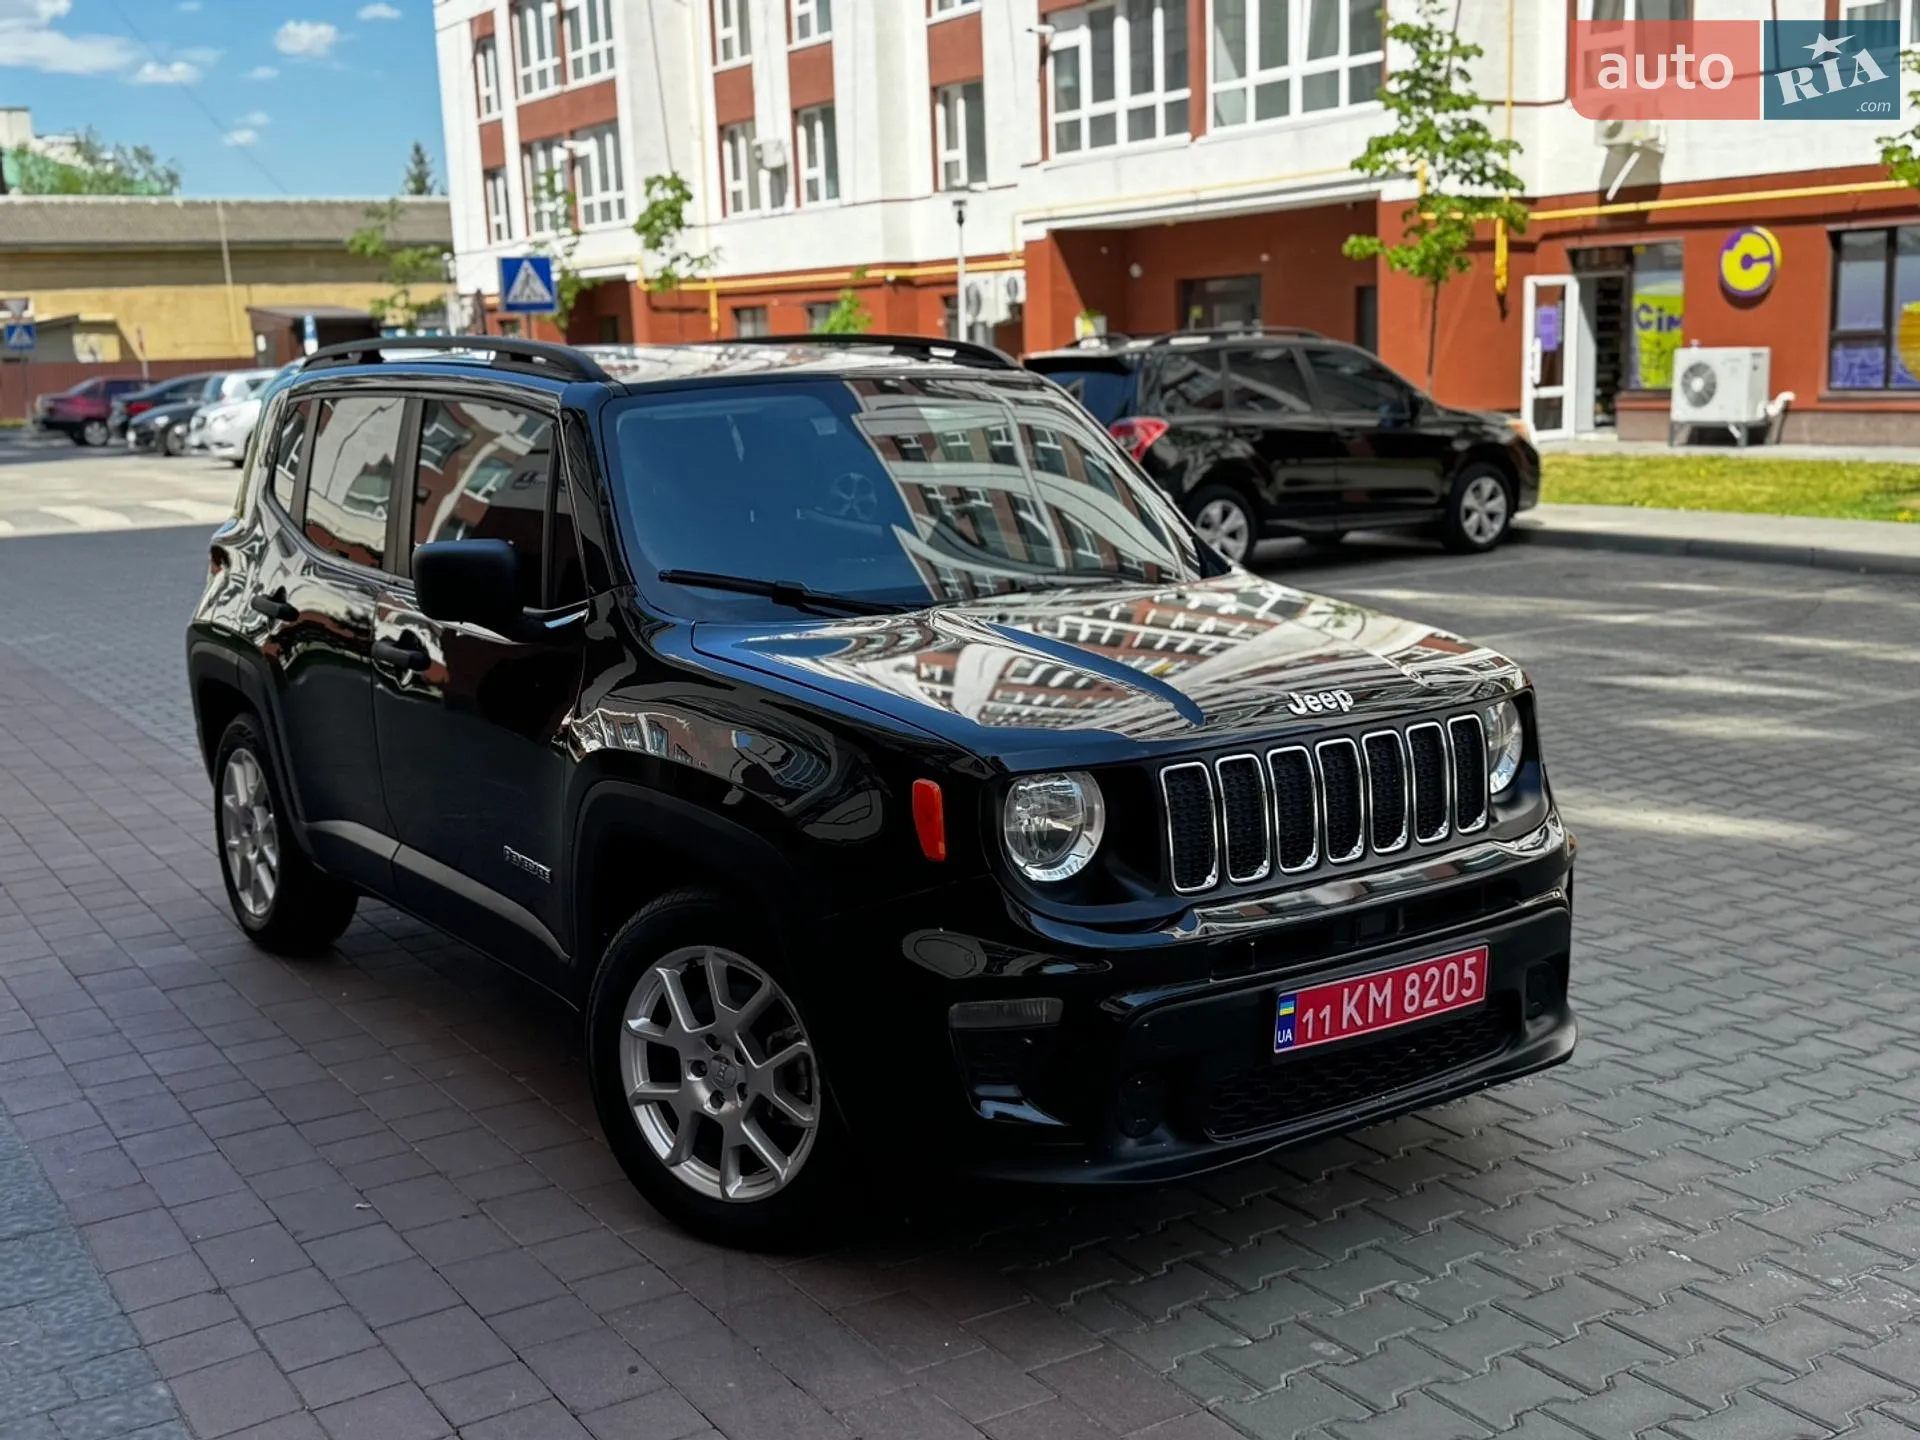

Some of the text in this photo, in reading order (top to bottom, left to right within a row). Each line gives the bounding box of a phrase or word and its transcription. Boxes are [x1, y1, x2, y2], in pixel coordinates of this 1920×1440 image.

[1287, 689, 1354, 715] Jeep
[1302, 956, 1477, 1040] 11 KM 8205
[1277, 1029, 1293, 1043] UA
